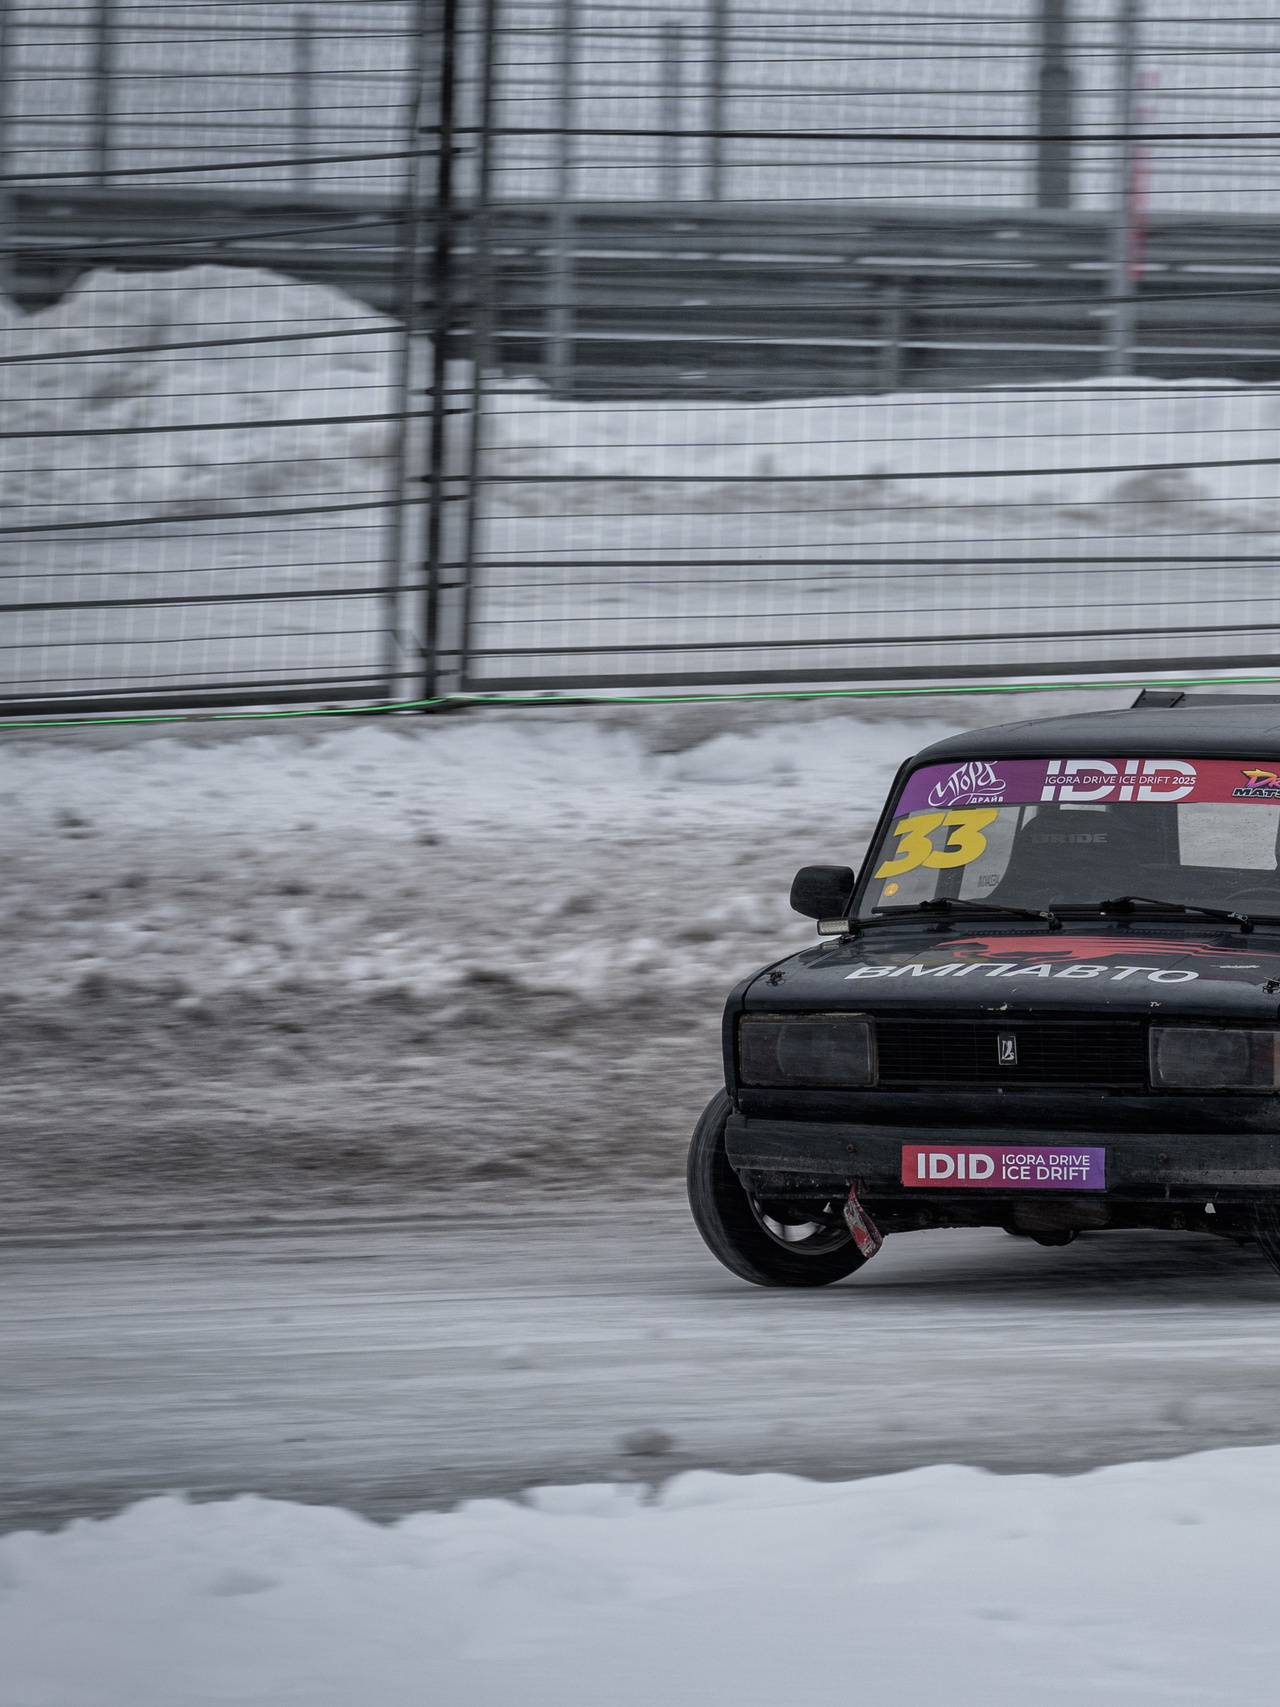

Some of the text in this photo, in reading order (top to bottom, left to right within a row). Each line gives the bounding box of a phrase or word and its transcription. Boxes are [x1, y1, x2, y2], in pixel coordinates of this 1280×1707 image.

[1040, 759, 1197, 801] IDID
[1045, 775, 1197, 785] IGORA DRIVE ICE DRIFT 2025
[875, 808, 999, 879] 33
[844, 963, 1199, 983] ВМПАВТО
[917, 1153, 1090, 1179] IDID IGORA DRIVE
[1002, 1166, 1090, 1181] ICE DRIFT
